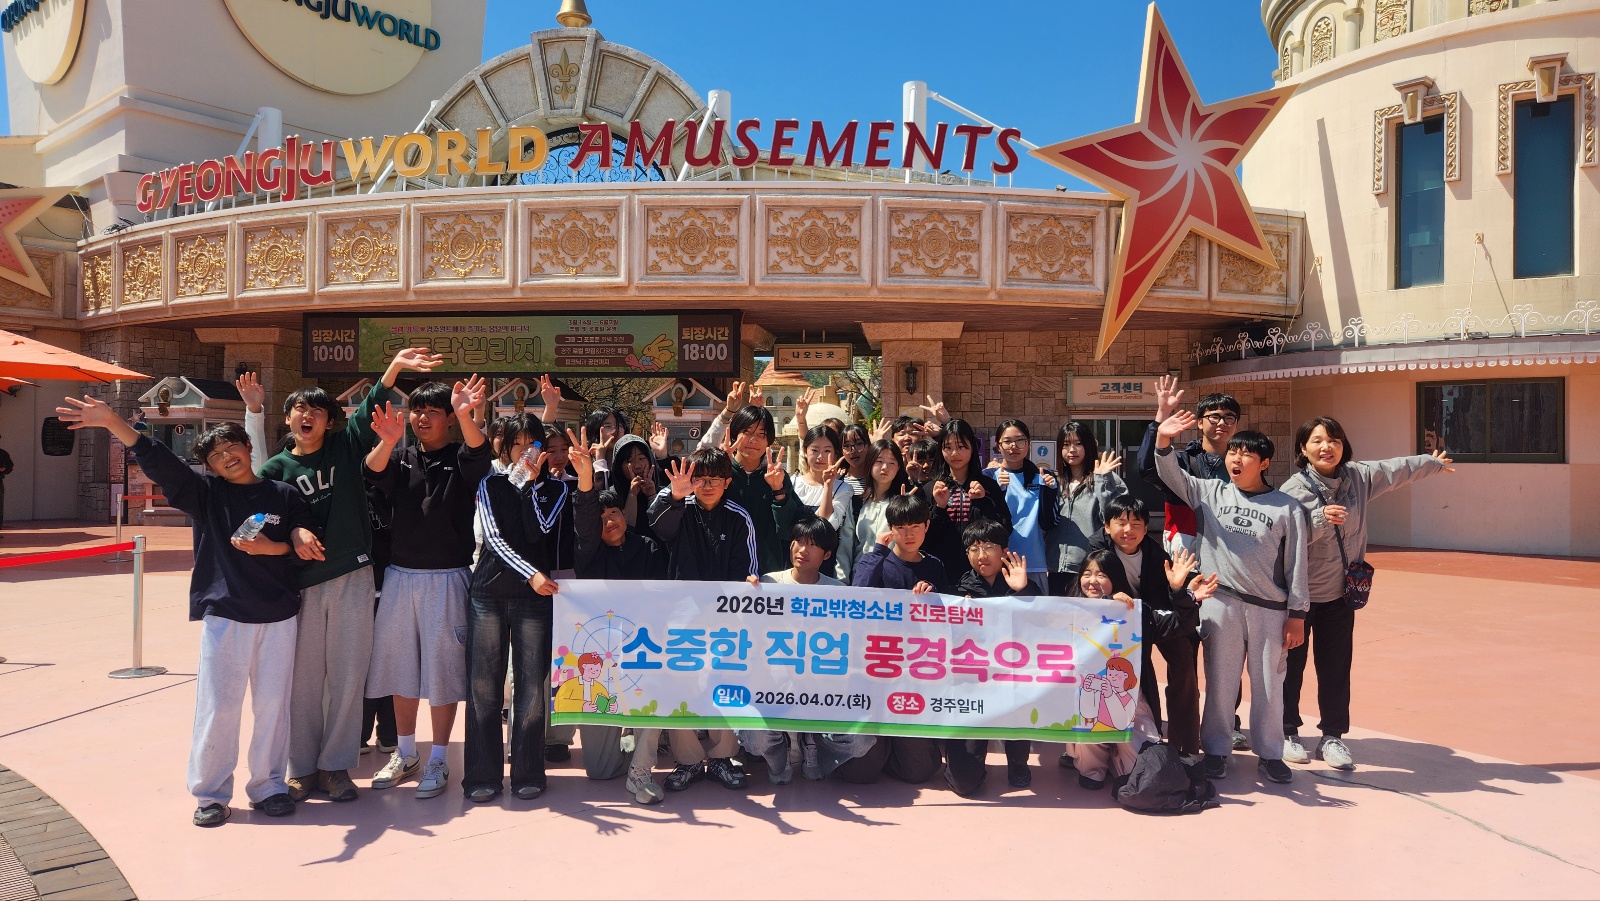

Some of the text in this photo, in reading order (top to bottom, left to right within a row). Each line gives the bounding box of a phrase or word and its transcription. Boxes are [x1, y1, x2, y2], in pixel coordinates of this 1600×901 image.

[351, 2, 441, 51] WORLD
[135, 118, 1022, 214] GYEONGJU WORLD AMUSEMENTS
[311, 329, 356, 343] 입장시간
[681, 326, 730, 341] 퇴장시간
[312, 344, 355, 362] 10:00
[682, 343, 728, 361] 18:00
[1099, 382, 1143, 394] 고객센터
[1217, 505, 1274, 531] OUTDOOR
[1237, 517, 1248, 526] 73
[1225, 525, 1258, 538] PRODUCTS
[716, 595, 984, 627] 2026년 학교밖청소년 진로탐색
[621, 627, 1077, 684] 소중한 직업 풍경속으로
[717, 688, 984, 715] 일시 2026.04.07.(화) 장소 경주일대
